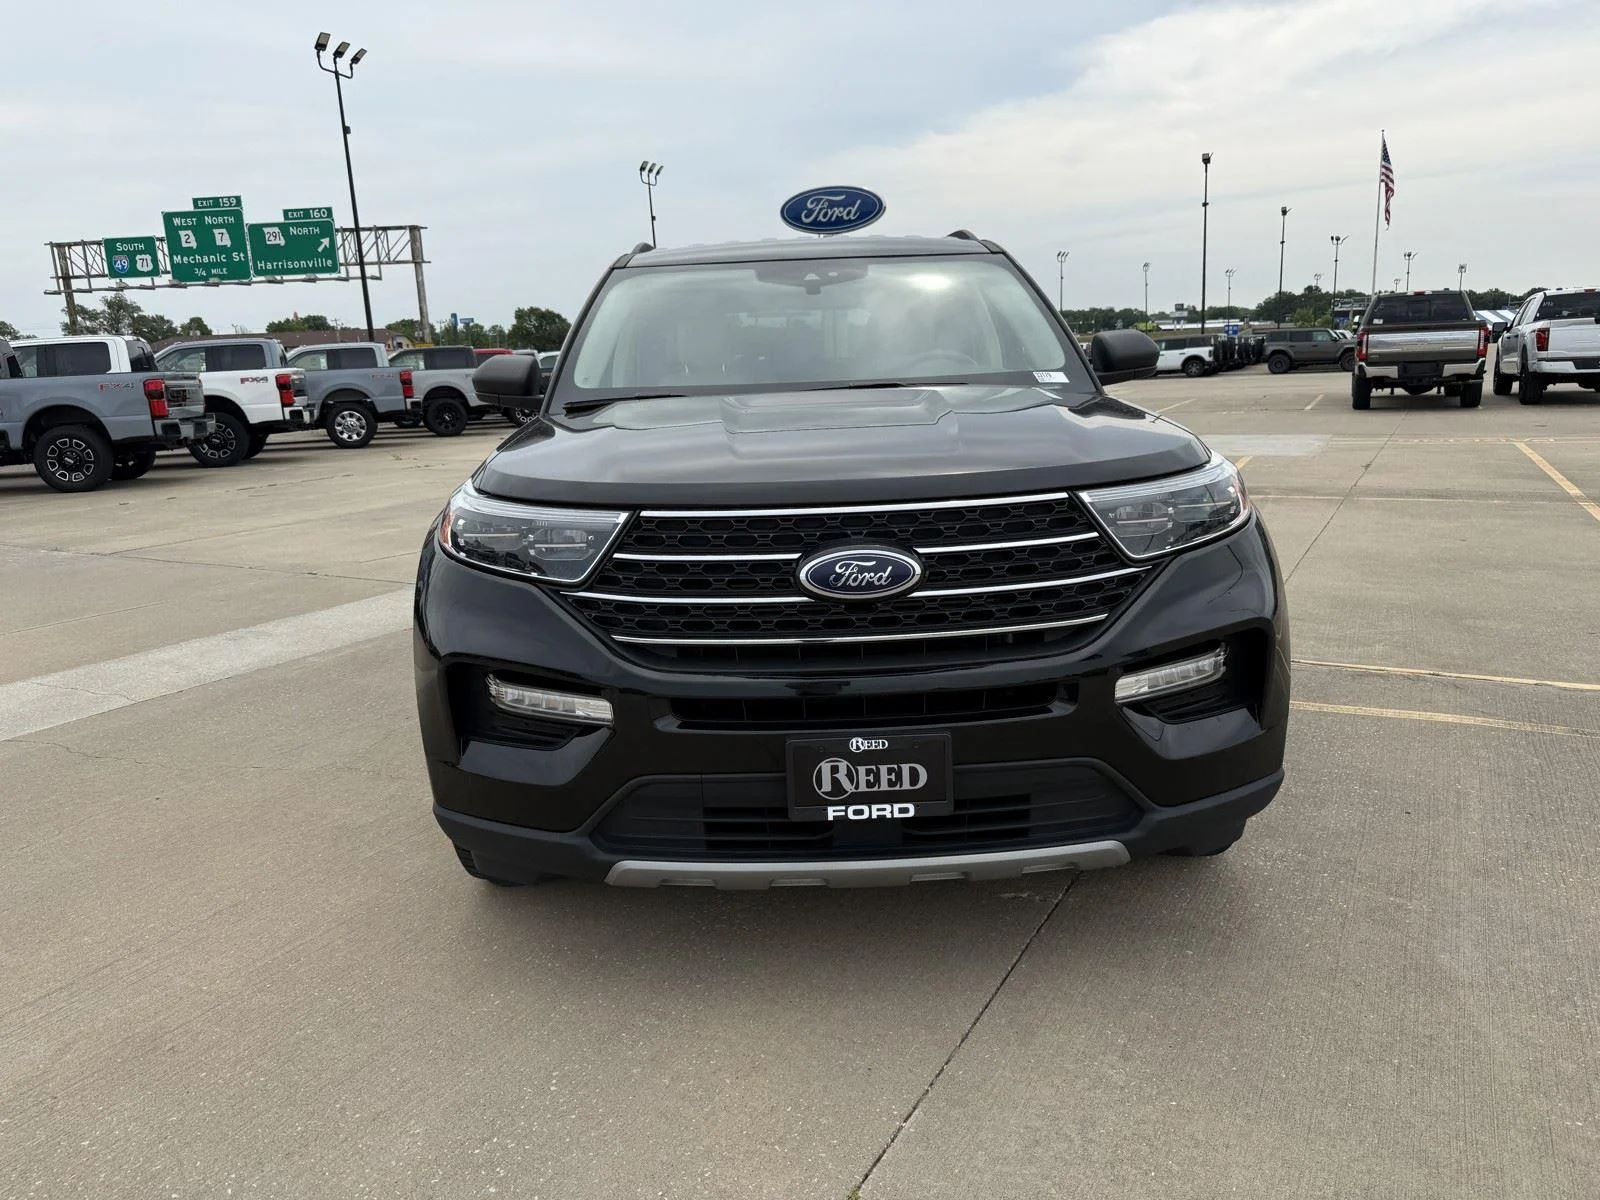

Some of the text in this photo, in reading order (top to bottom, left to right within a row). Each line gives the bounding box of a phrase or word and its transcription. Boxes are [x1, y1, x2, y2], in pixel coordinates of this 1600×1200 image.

[219, 197, 237, 207] 159
[309, 208, 328, 218] 160
[801, 195, 861, 223] Ford
[172, 215, 235, 226] WEST NORTH
[289, 226, 320, 235] NORTH
[184, 233, 191, 244] 2
[217, 232, 224, 242] 7
[266, 231, 281, 242] 291
[116, 242, 145, 251] SOUTH
[138, 257, 149, 268] 71
[173, 252, 245, 264] Mechanic St
[257, 257, 333, 270] Harrisonville
[115, 259, 128, 270] 49
[240, 376, 268, 385] FX4
[98, 382, 135, 391] FX4
[829, 560, 893, 588] Ford
[849, 737, 888, 753] REED
[813, 757, 928, 800] REED
[827, 803, 915, 821] FORD
